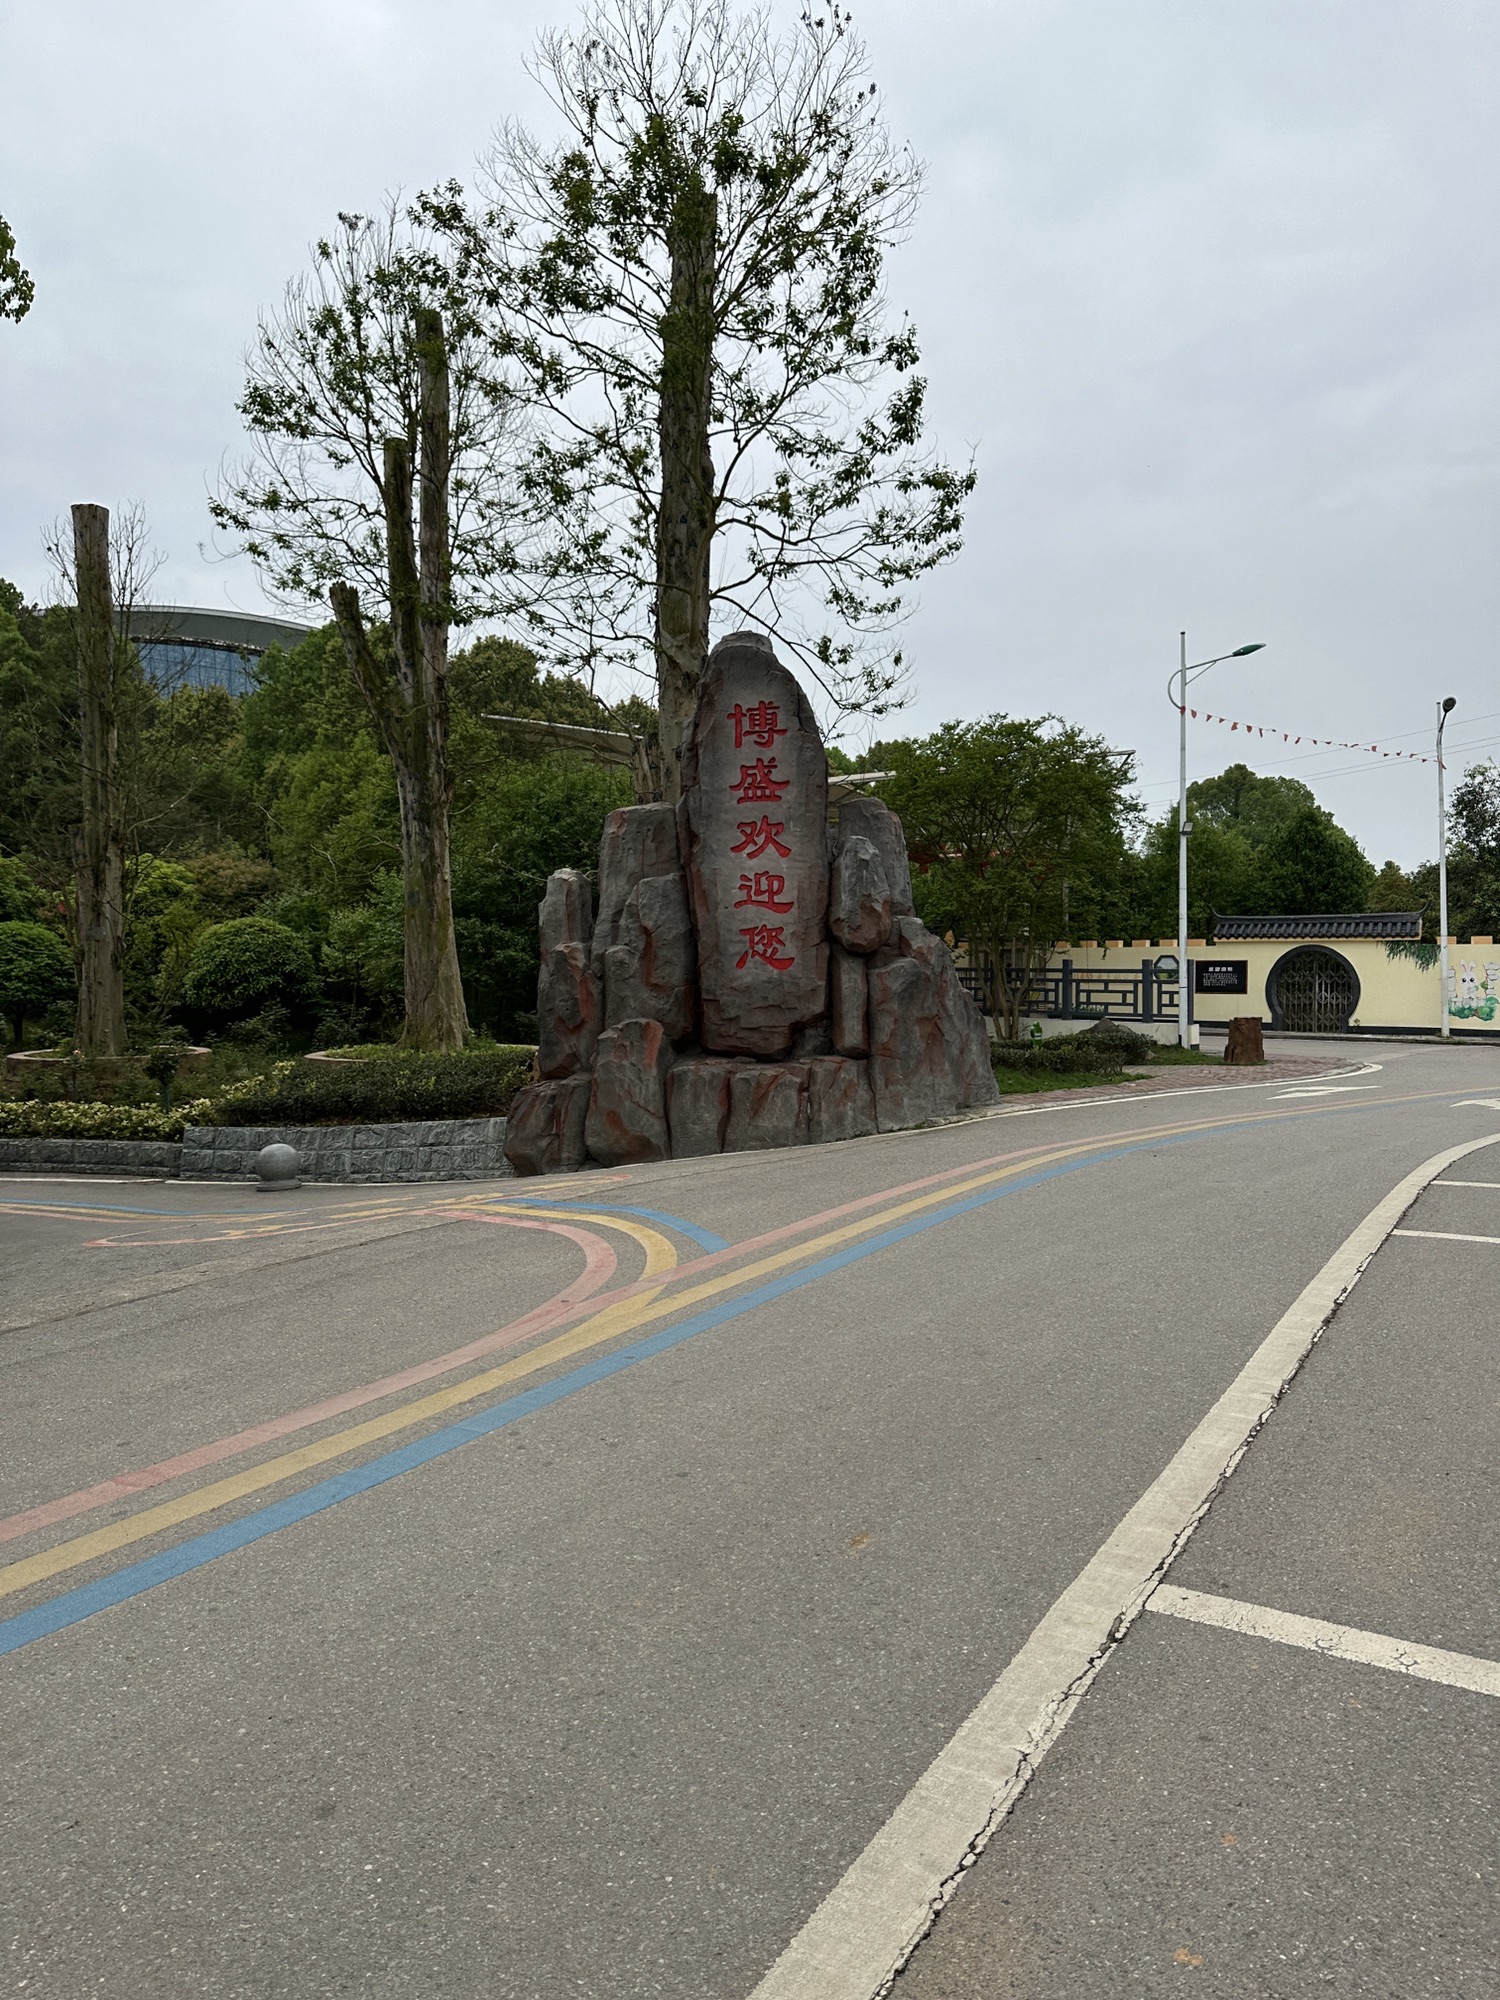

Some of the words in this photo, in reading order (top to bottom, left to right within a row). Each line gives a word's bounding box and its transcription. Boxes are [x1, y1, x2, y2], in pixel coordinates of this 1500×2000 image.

[726, 700, 796, 971] 博盛欢迎您
